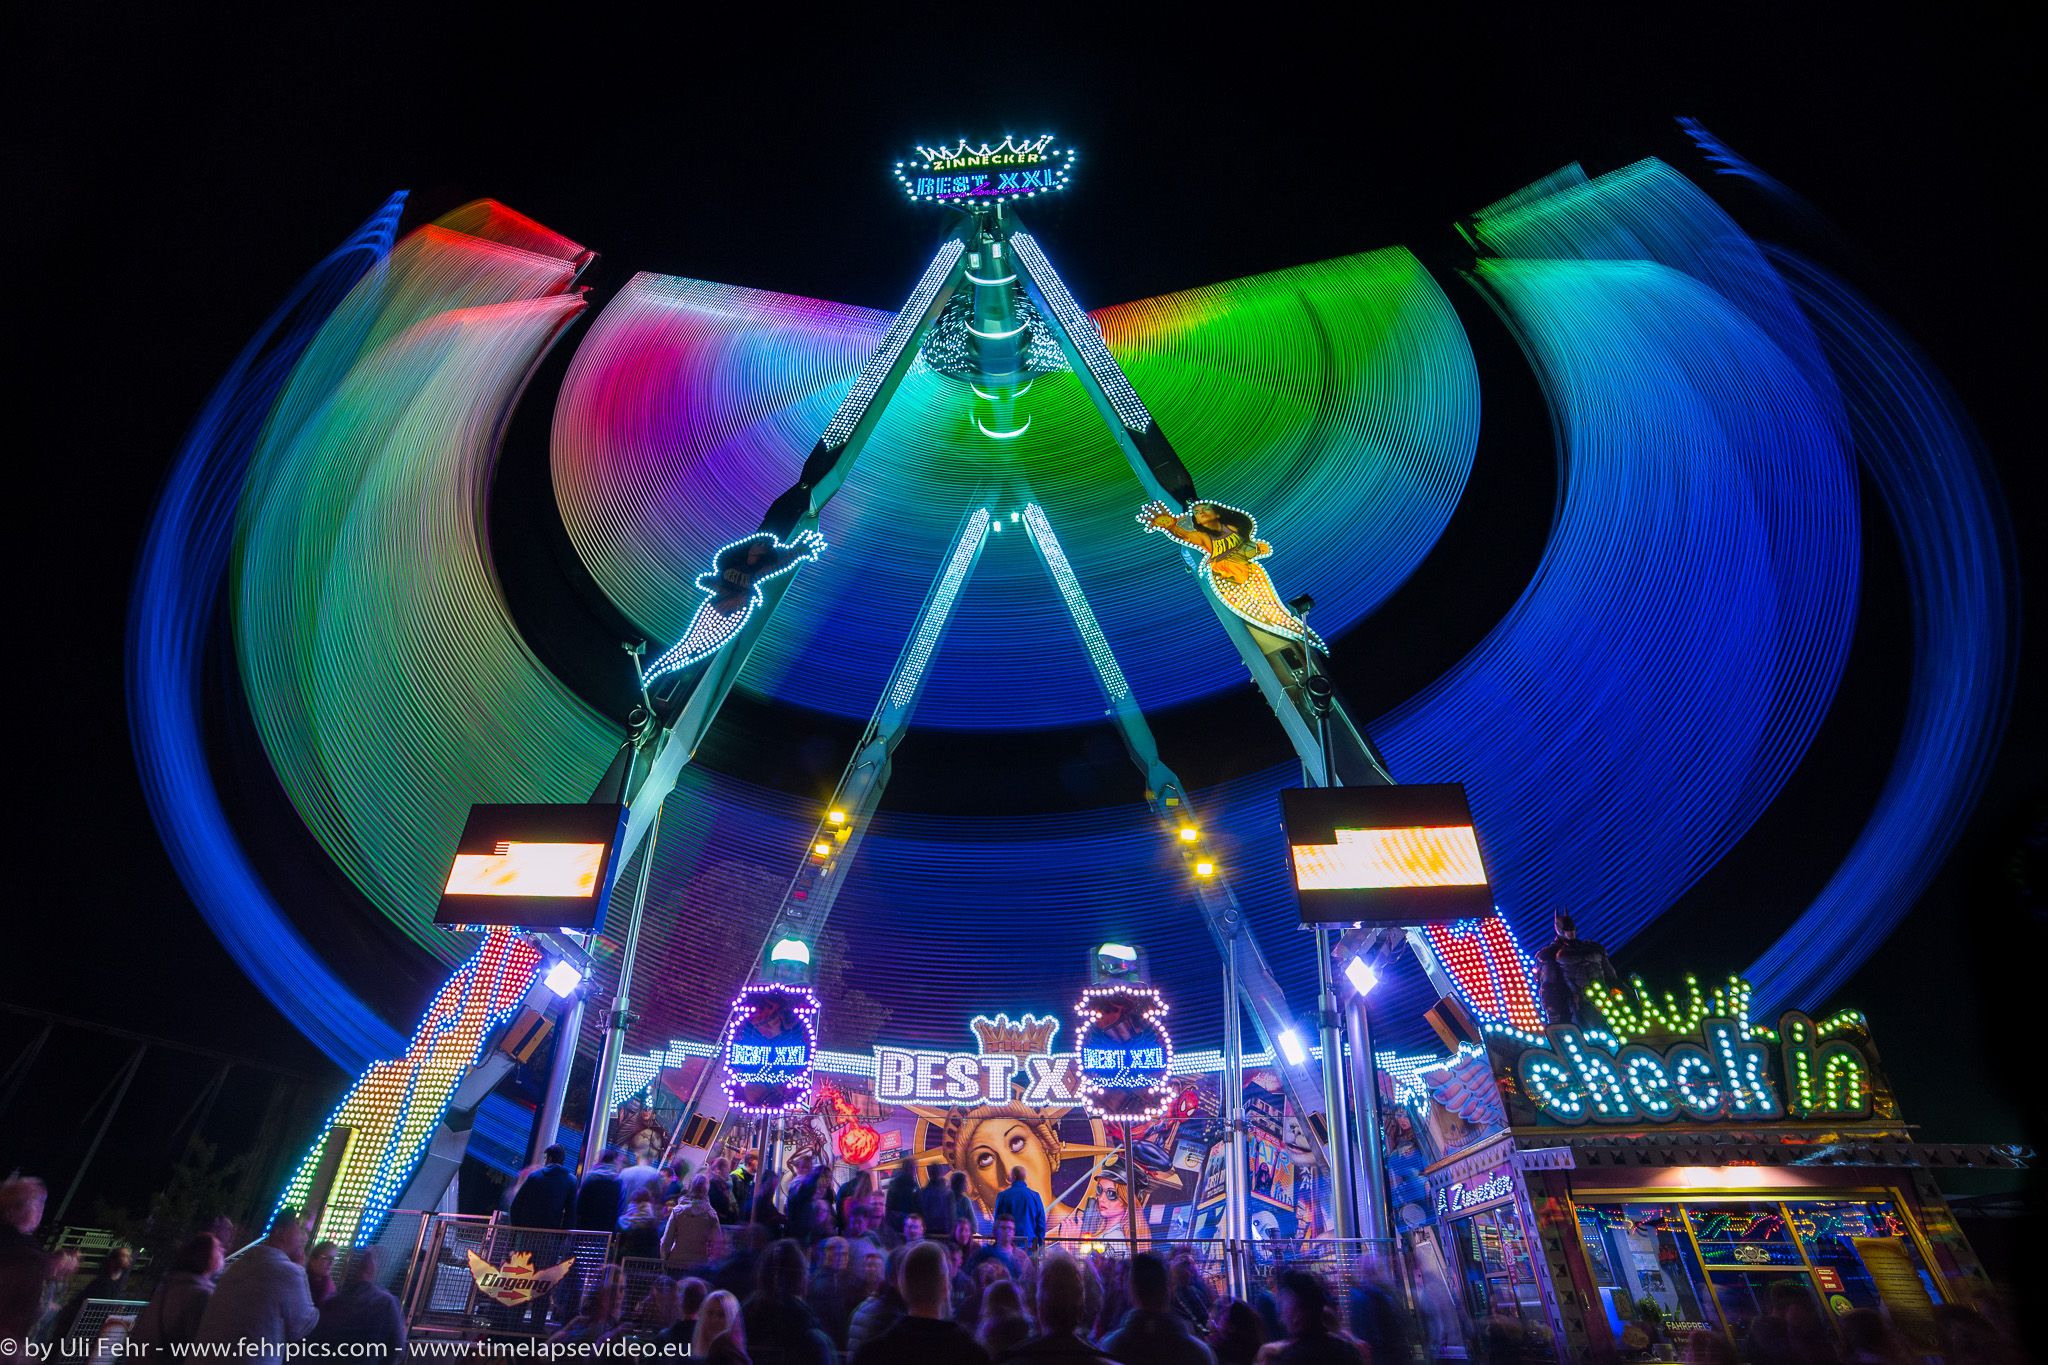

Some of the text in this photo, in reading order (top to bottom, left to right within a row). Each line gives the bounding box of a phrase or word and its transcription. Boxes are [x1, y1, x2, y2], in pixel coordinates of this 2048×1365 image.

[932, 153, 1039, 171] ZINNECKER
[916, 168, 1060, 196] BEST XXL
[731, 1043, 808, 1066] BEST XXL
[1083, 1047, 1167, 1069] BEST XXL
[881, 1051, 1013, 1099] BEST
[1524, 1016, 1865, 1120] check in
[480, 1272, 552, 1293] Eingang
